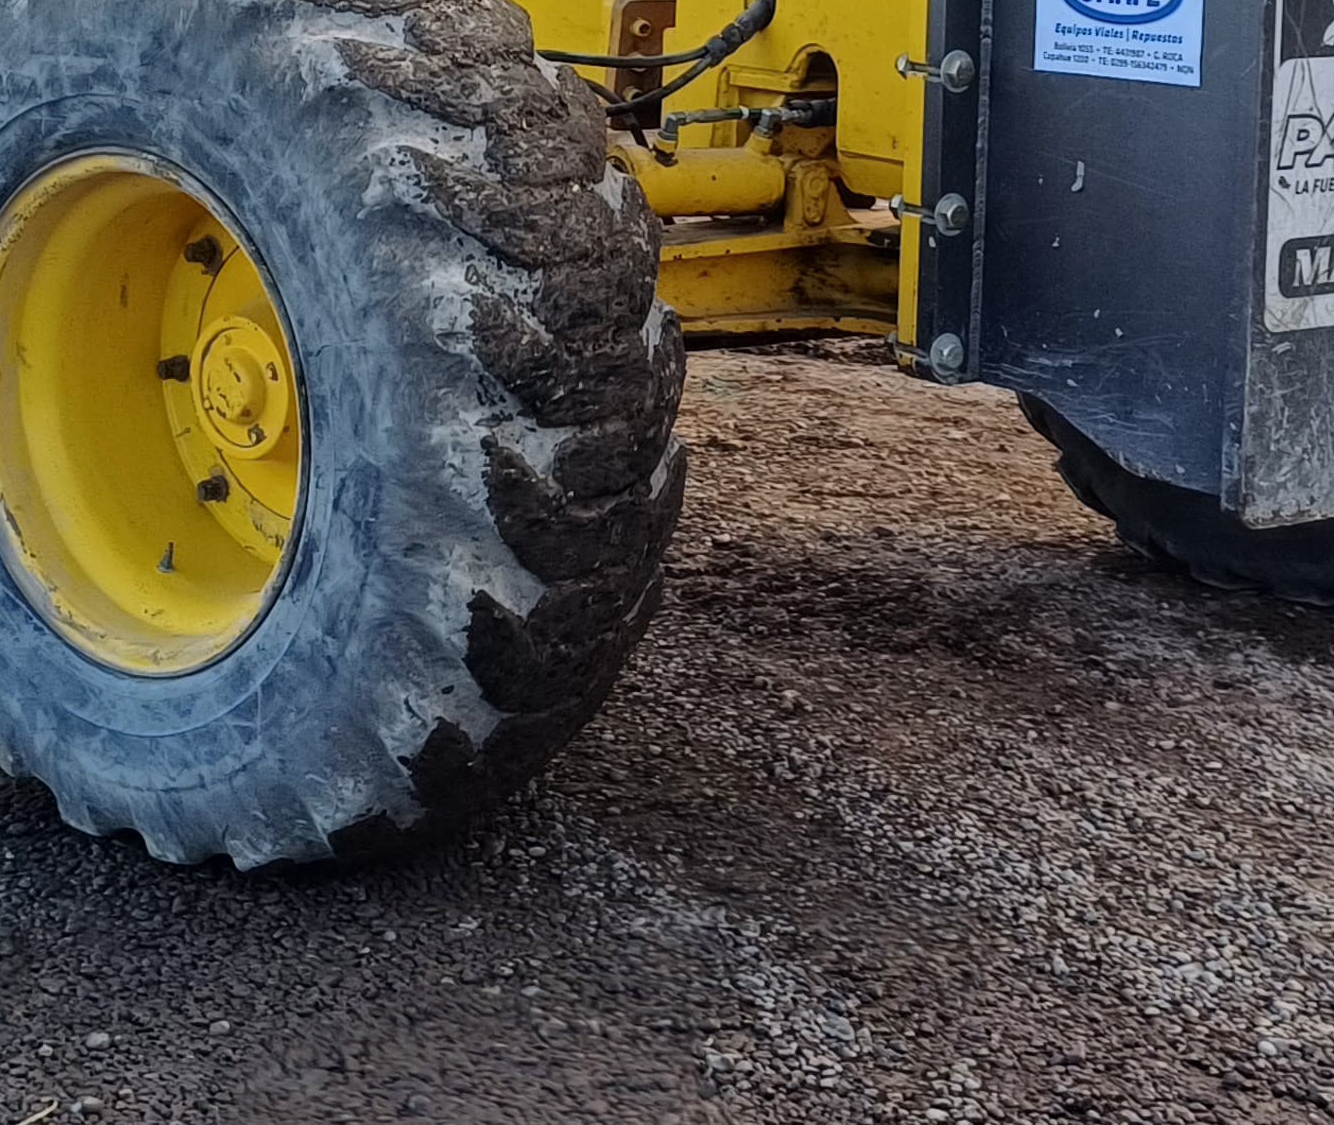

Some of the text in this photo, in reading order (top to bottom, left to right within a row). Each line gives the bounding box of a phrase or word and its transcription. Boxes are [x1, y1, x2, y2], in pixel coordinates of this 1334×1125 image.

[1055, 22, 1184, 44] Equipos Viales Repuestos
[1295, 179, 1309, 195] LA
